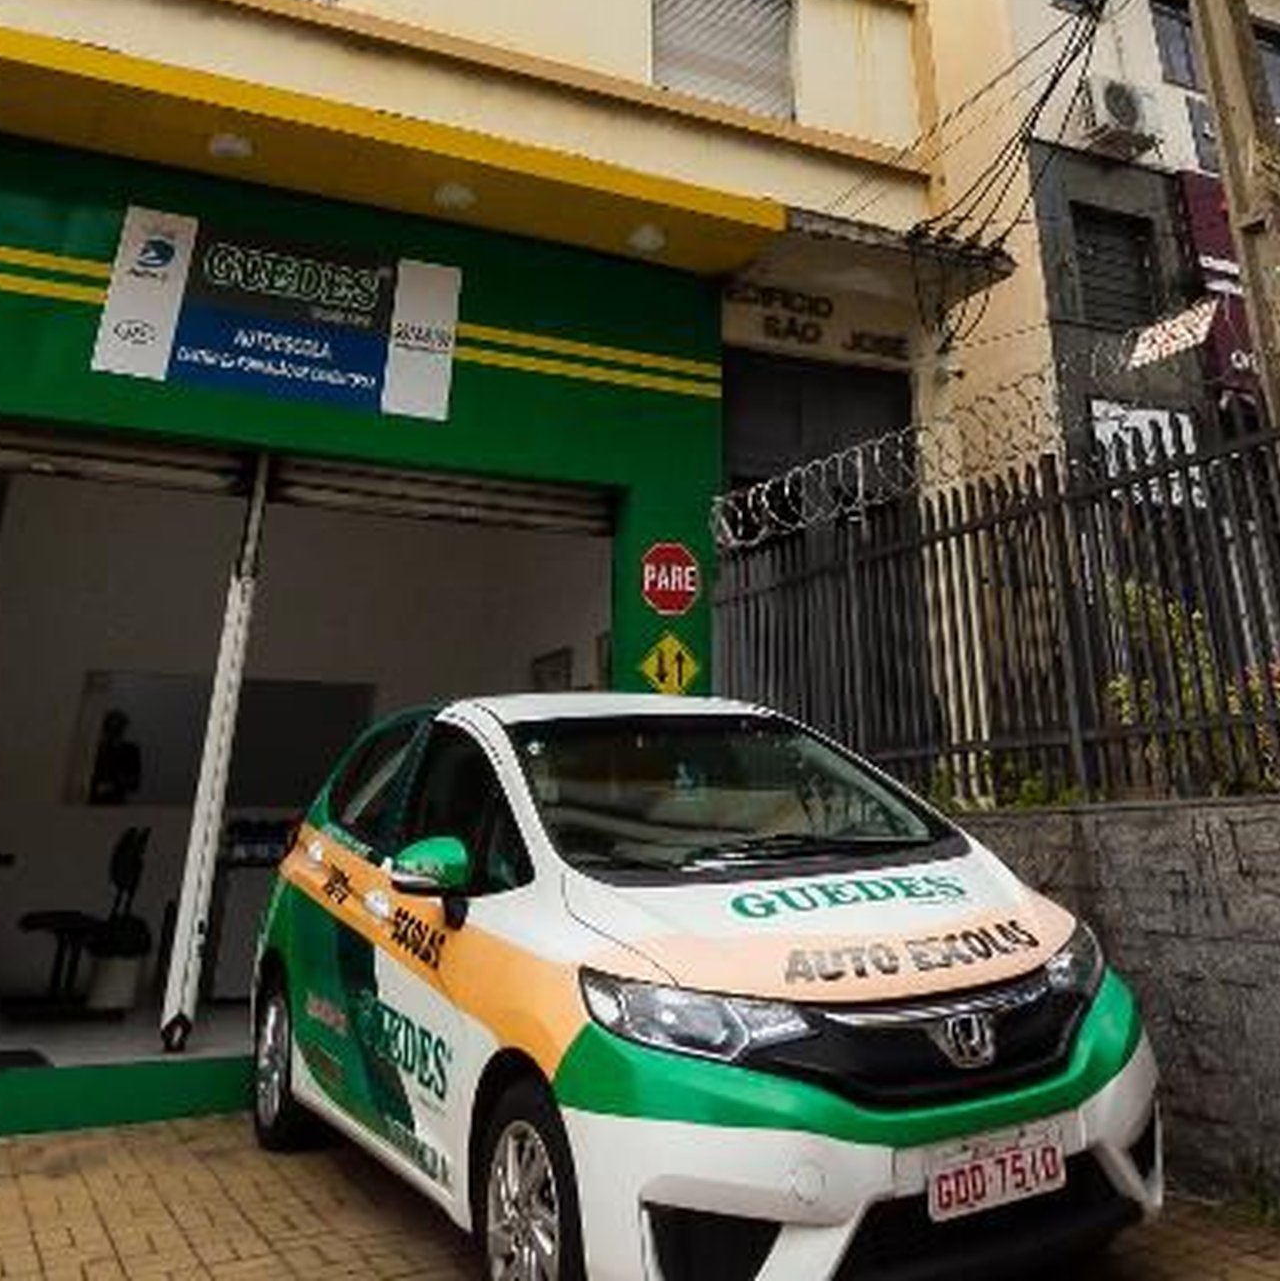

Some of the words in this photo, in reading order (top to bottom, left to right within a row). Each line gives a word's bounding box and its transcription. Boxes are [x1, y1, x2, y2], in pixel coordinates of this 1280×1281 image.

[643, 565, 697, 593] PARE
[730, 875, 967, 919] GUEDES
[784, 943, 900, 984] AUTO
